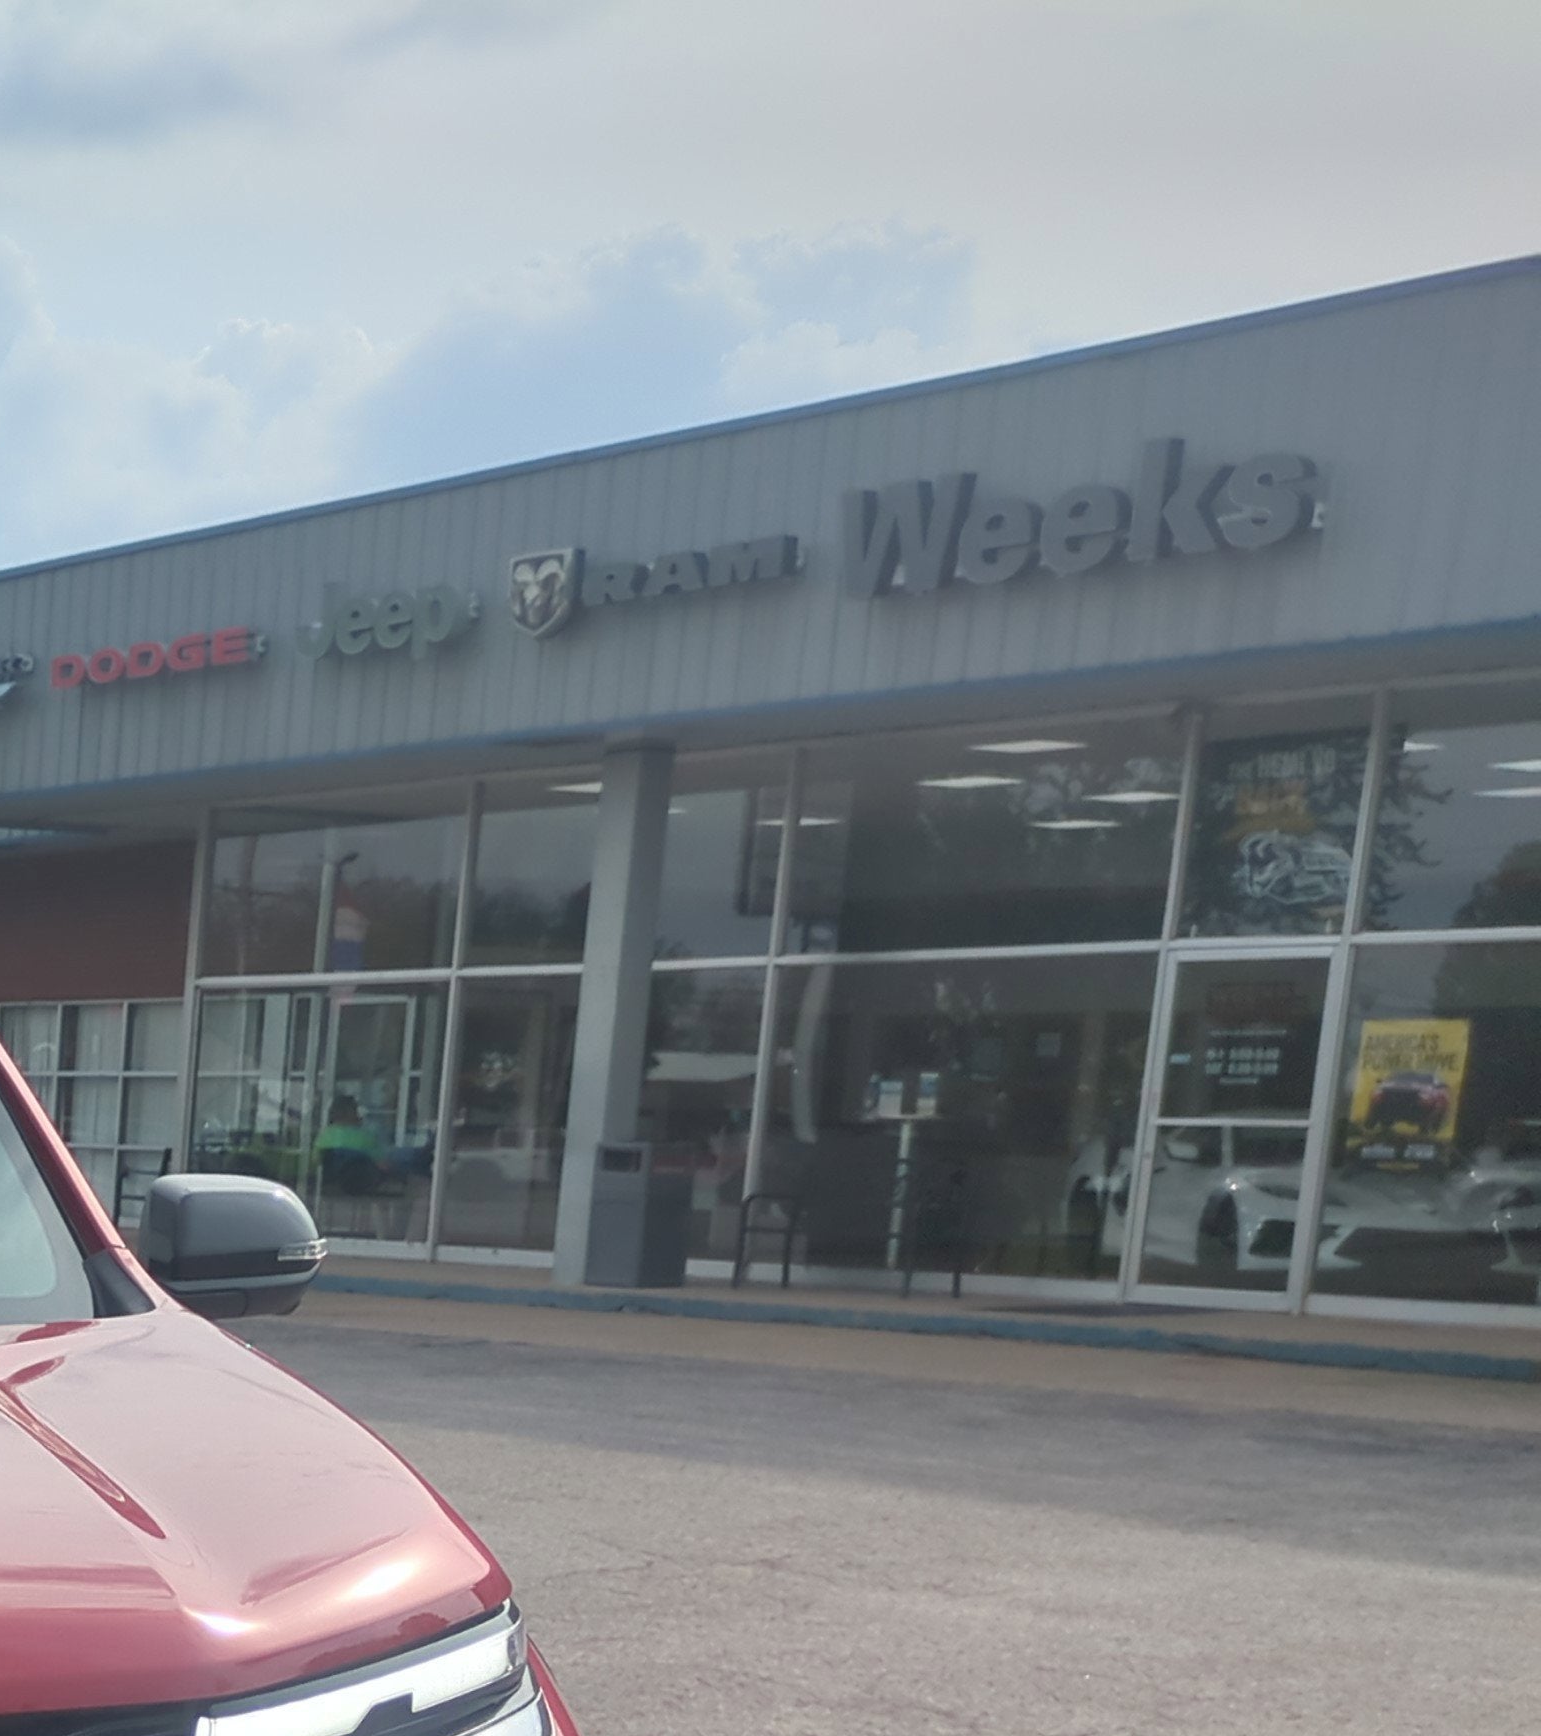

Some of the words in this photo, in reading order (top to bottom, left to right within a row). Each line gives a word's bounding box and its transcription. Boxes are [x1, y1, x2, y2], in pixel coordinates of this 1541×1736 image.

[839, 438, 1322, 597] Weeks
[585, 535, 797, 606] RAM
[297, 580, 472, 660] Jeep
[50, 626, 252, 690] DODGE
